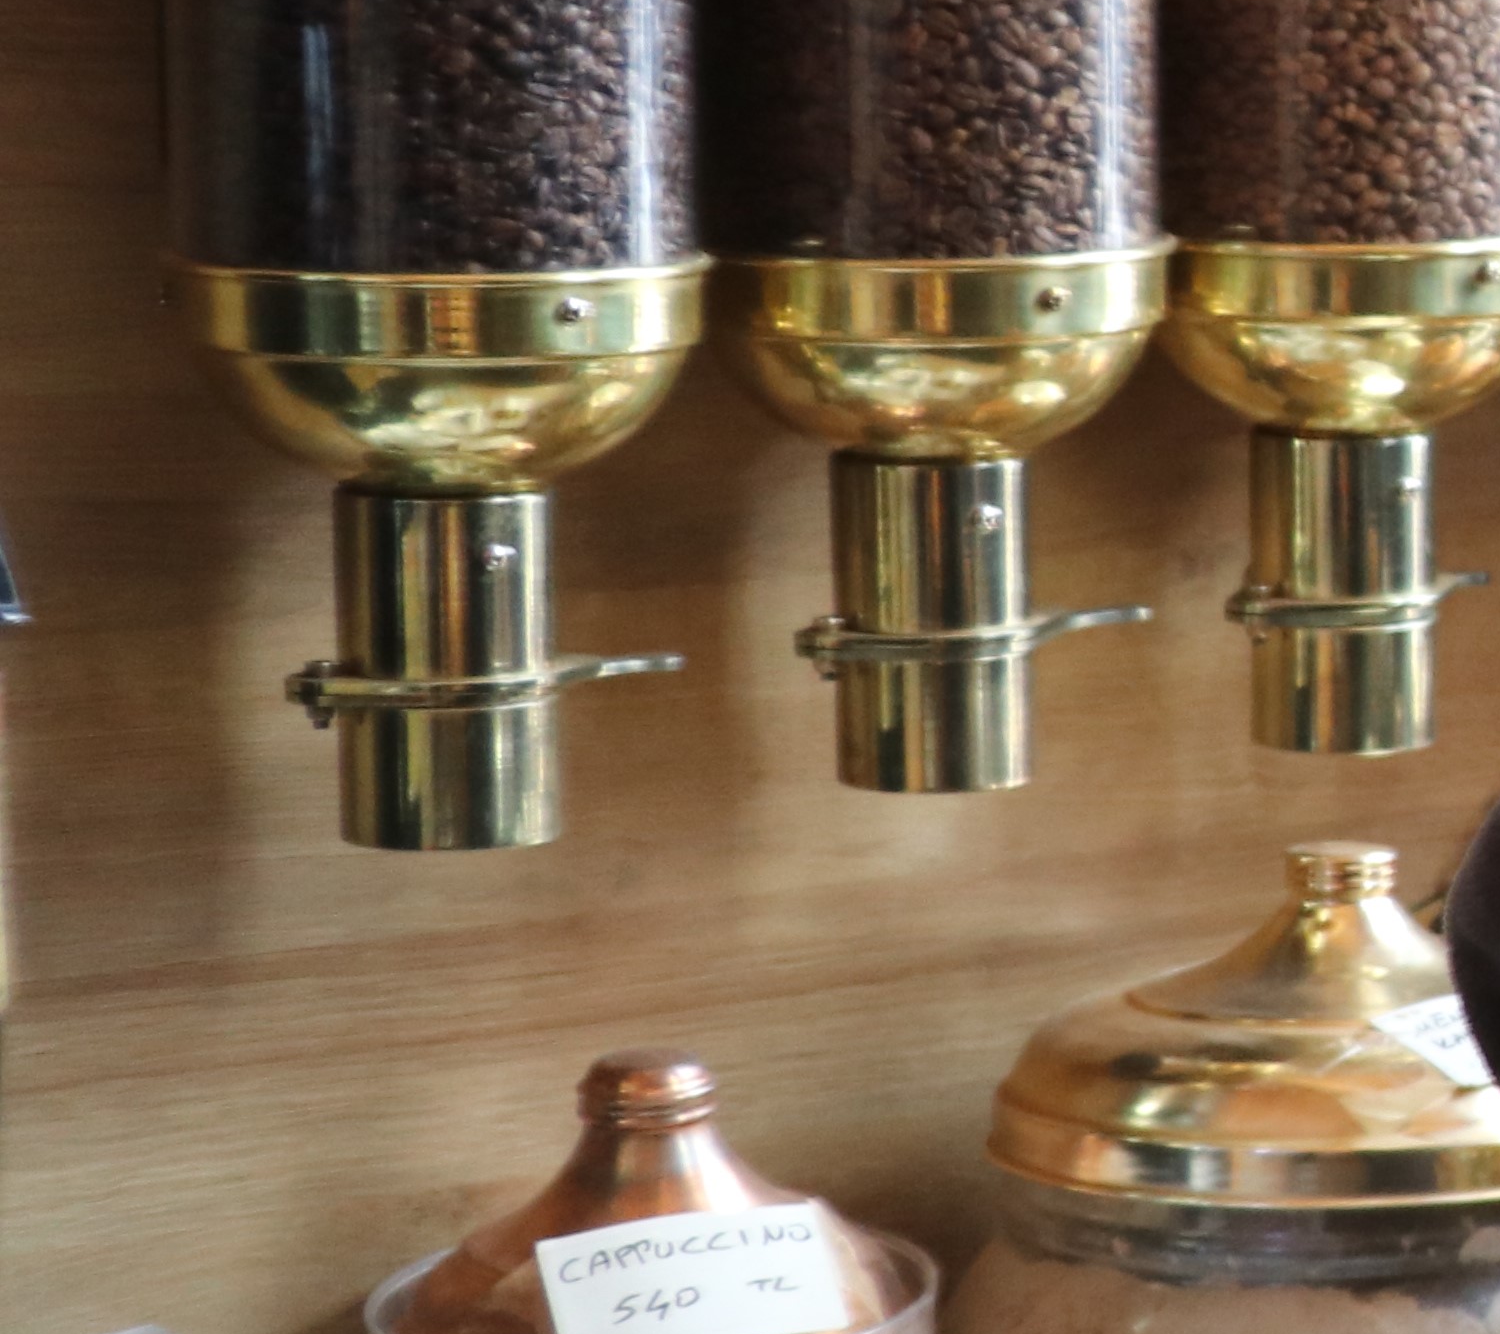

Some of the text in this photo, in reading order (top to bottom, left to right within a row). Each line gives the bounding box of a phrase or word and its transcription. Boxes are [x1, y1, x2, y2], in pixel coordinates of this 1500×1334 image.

[558, 1222, 813, 1284] CAPPUCCINO
[611, 1275, 800, 1325] 540 TL
